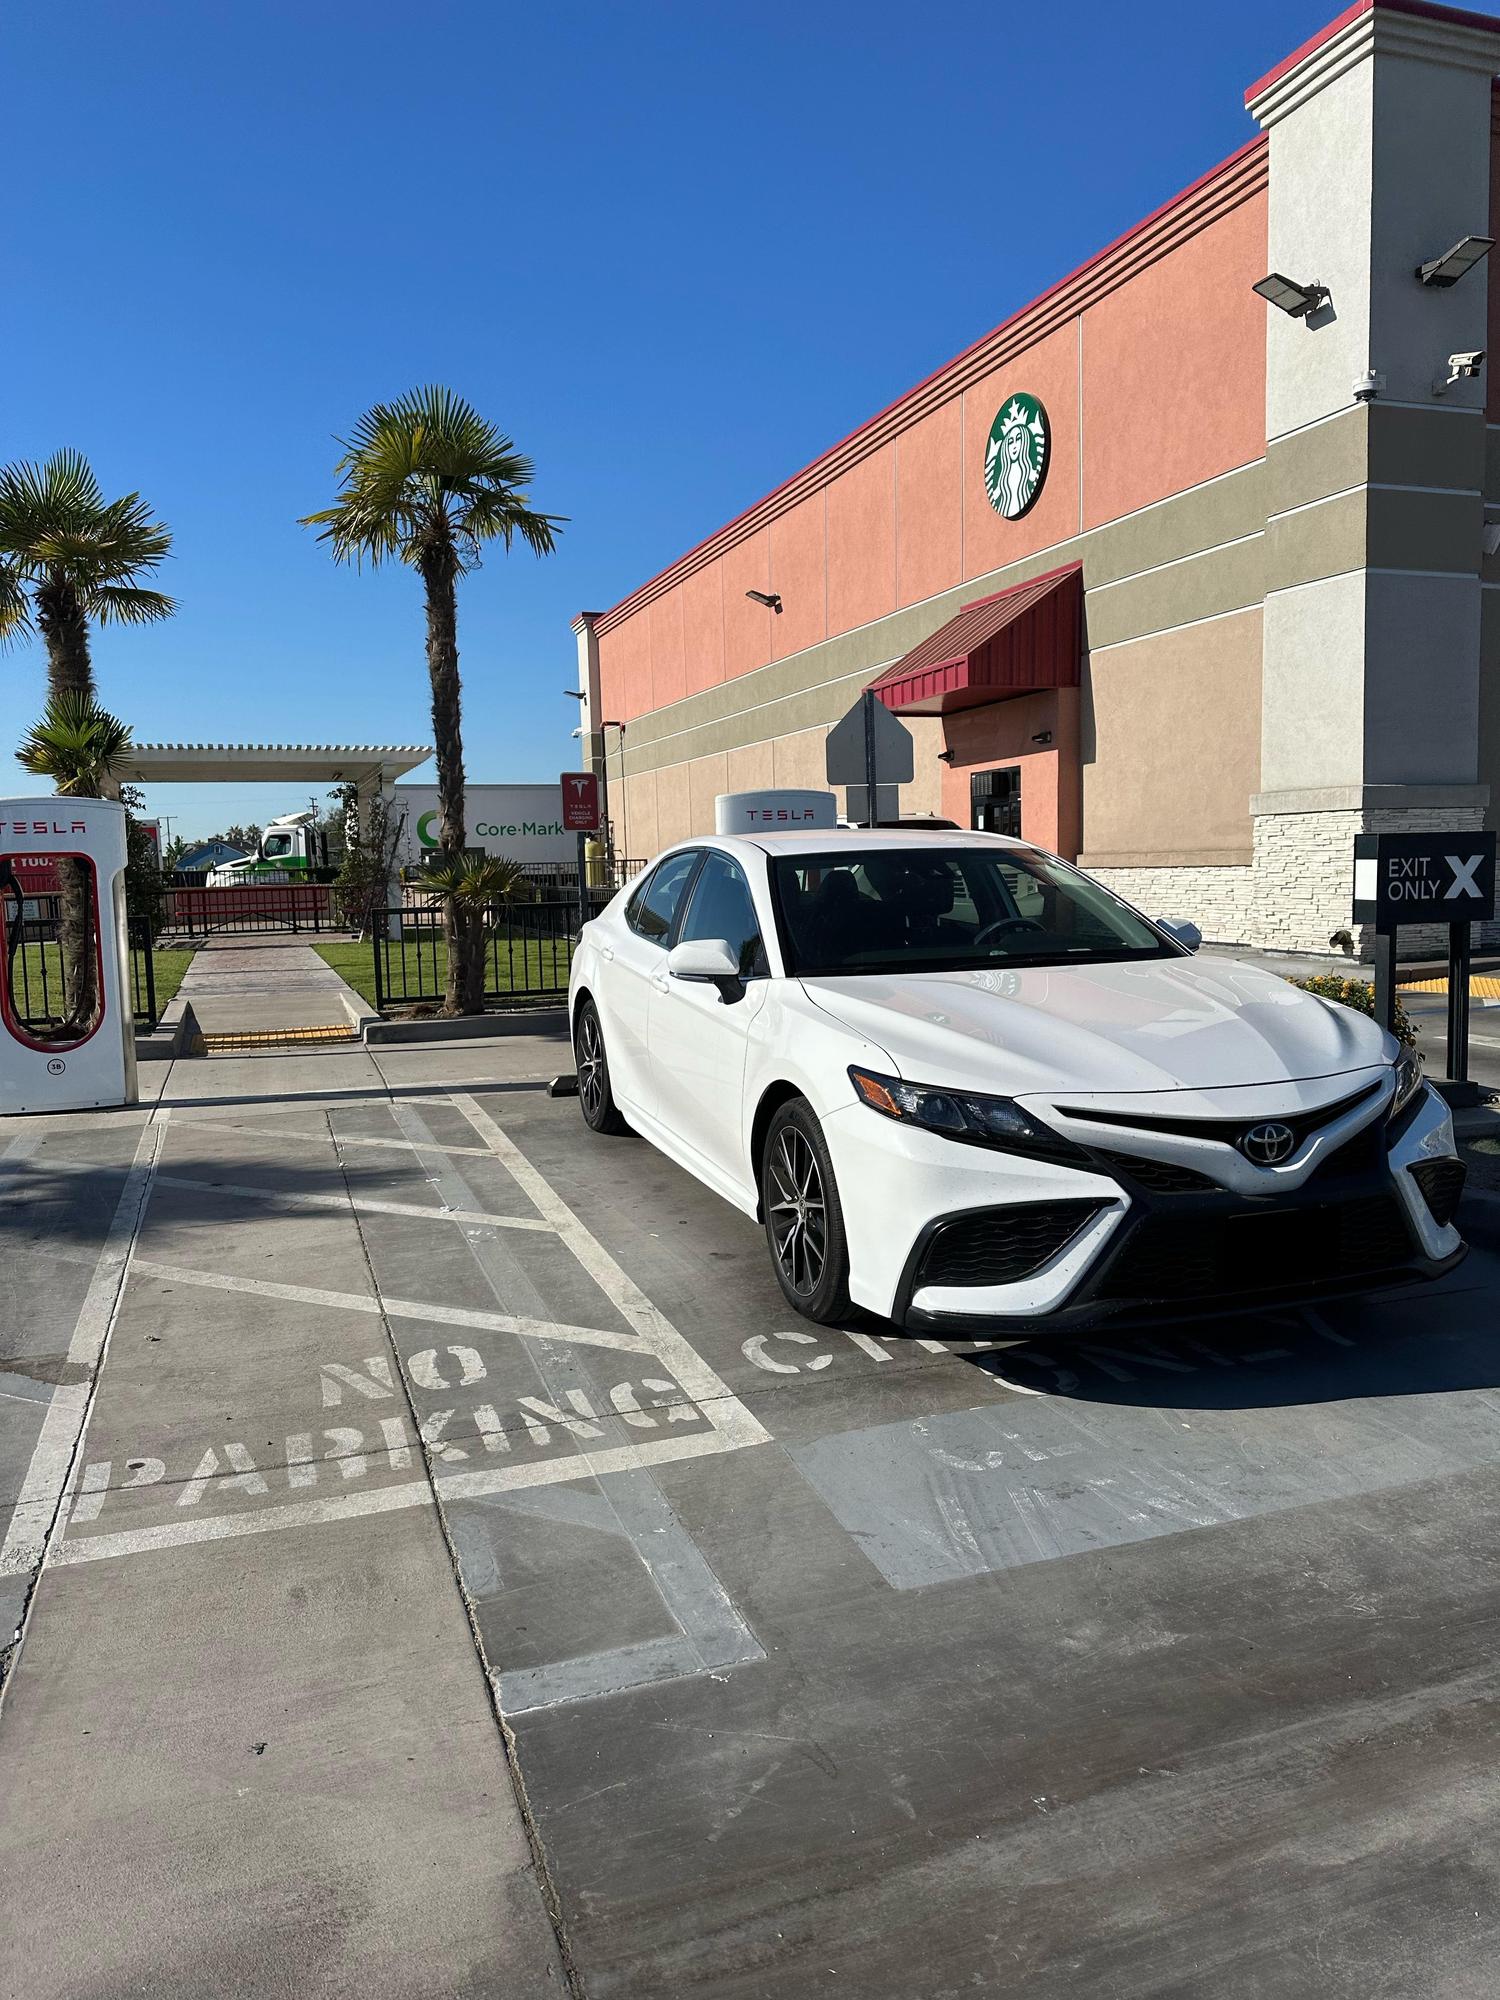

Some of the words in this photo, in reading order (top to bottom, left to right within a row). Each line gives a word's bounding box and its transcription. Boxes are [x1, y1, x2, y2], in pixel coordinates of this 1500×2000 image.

[746, 810, 814, 820] TESLA
[1388, 857, 1431, 878] EXIT
[1388, 880, 1440, 900] ONLY
[320, 1345, 487, 1406] NO
[70, 1378, 701, 1523] PARKING
